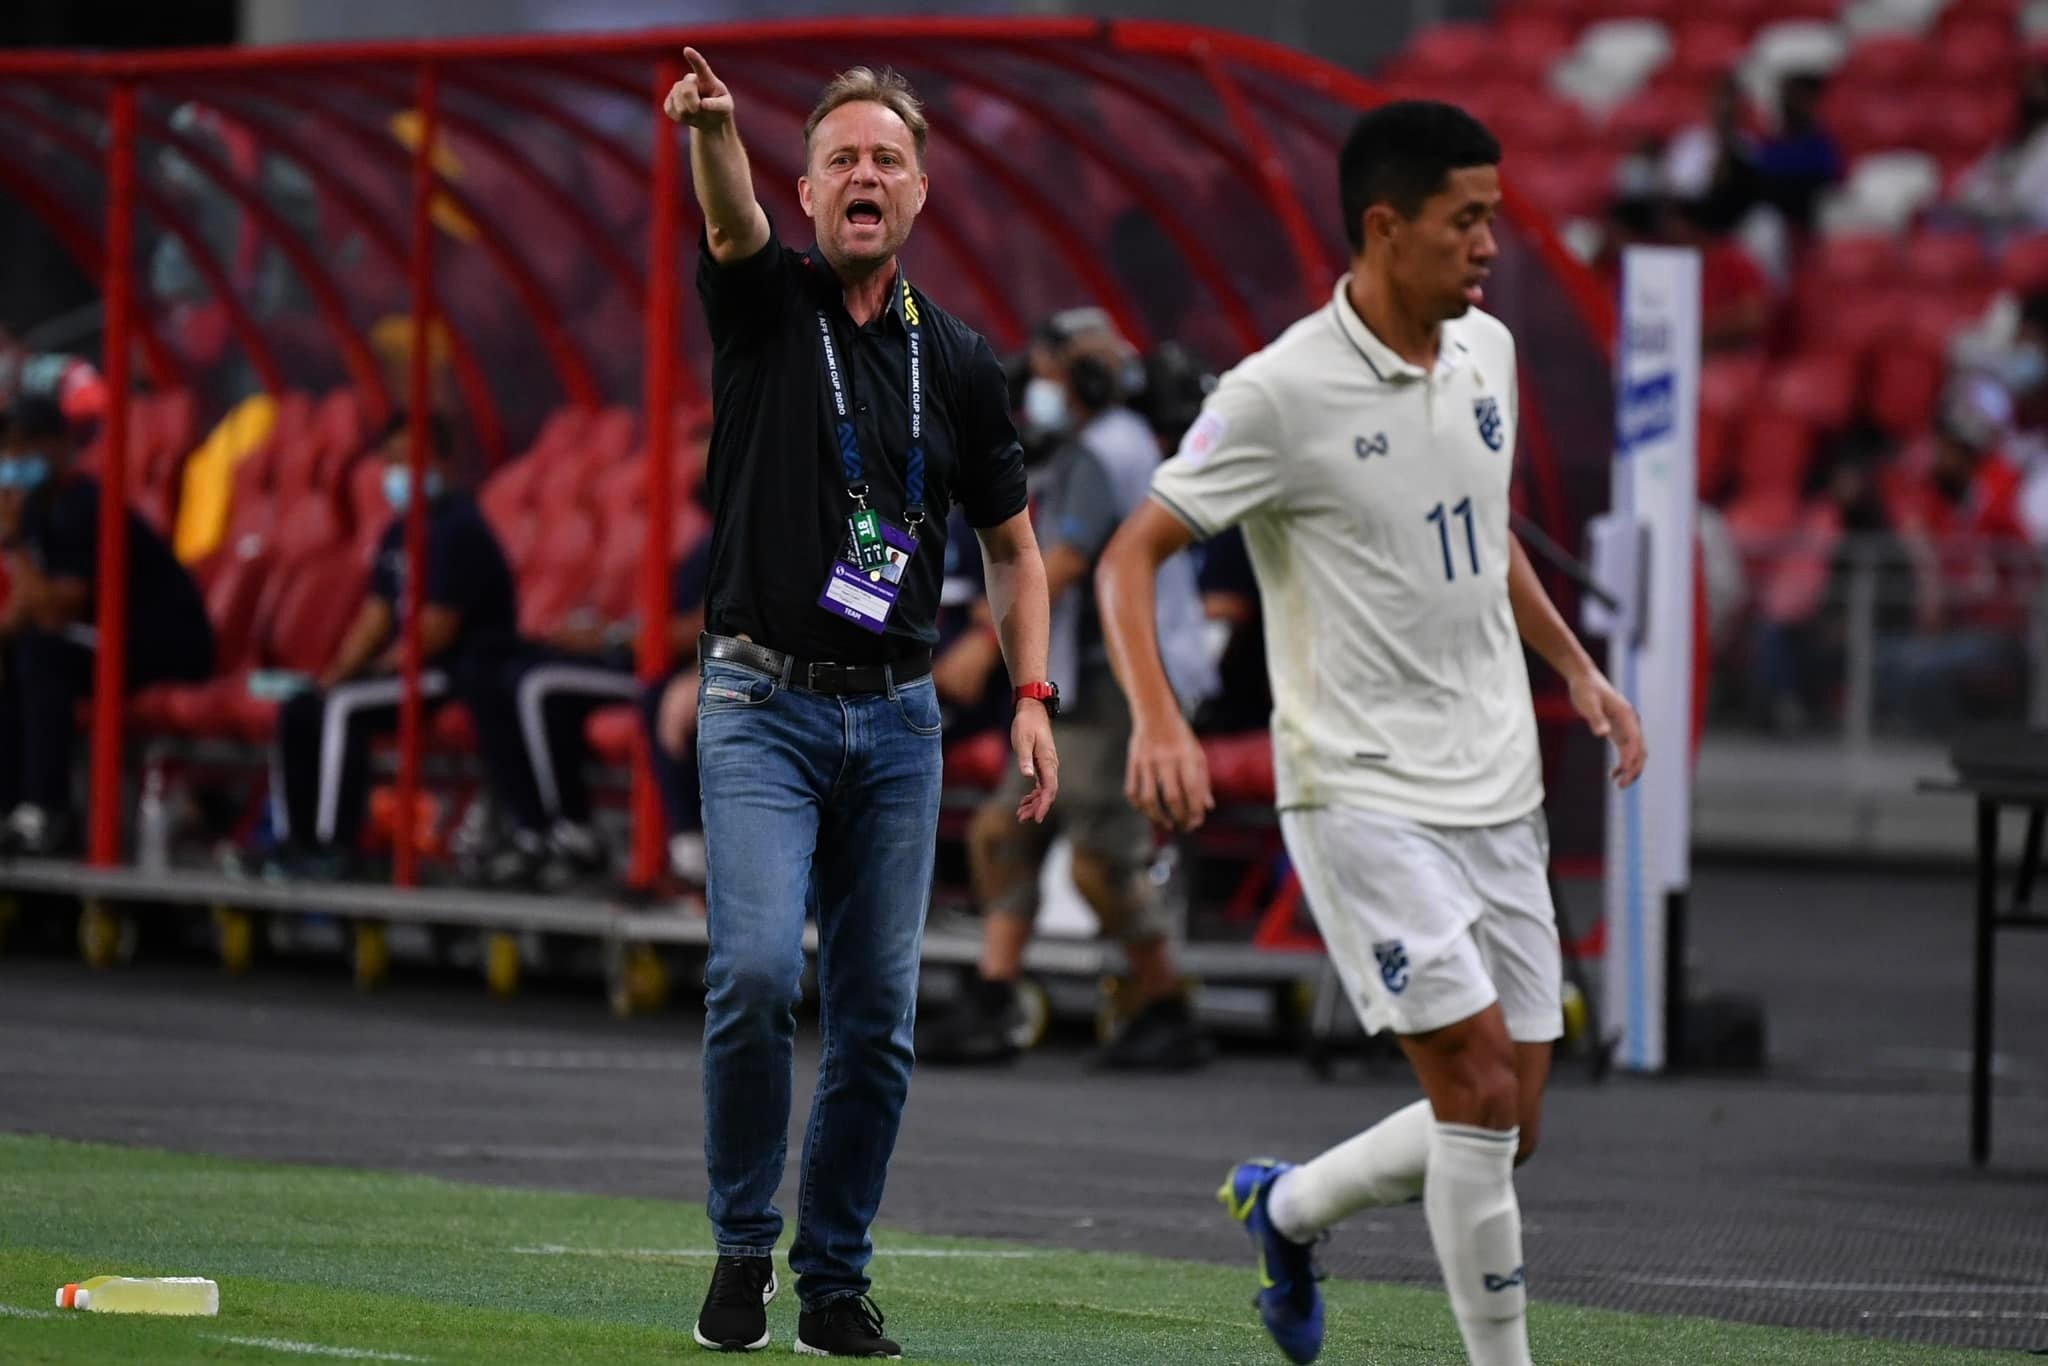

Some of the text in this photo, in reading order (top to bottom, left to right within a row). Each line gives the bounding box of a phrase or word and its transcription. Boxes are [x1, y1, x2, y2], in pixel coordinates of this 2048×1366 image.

[819, 317, 846, 416] AFF SUZUKI CUP 2020
[911, 340, 920, 438] AFF SUZUKI CUP 2020
[857, 520, 871, 536] 18
[1426, 496, 1480, 581] 11
[844, 607, 862, 620] TEAM
